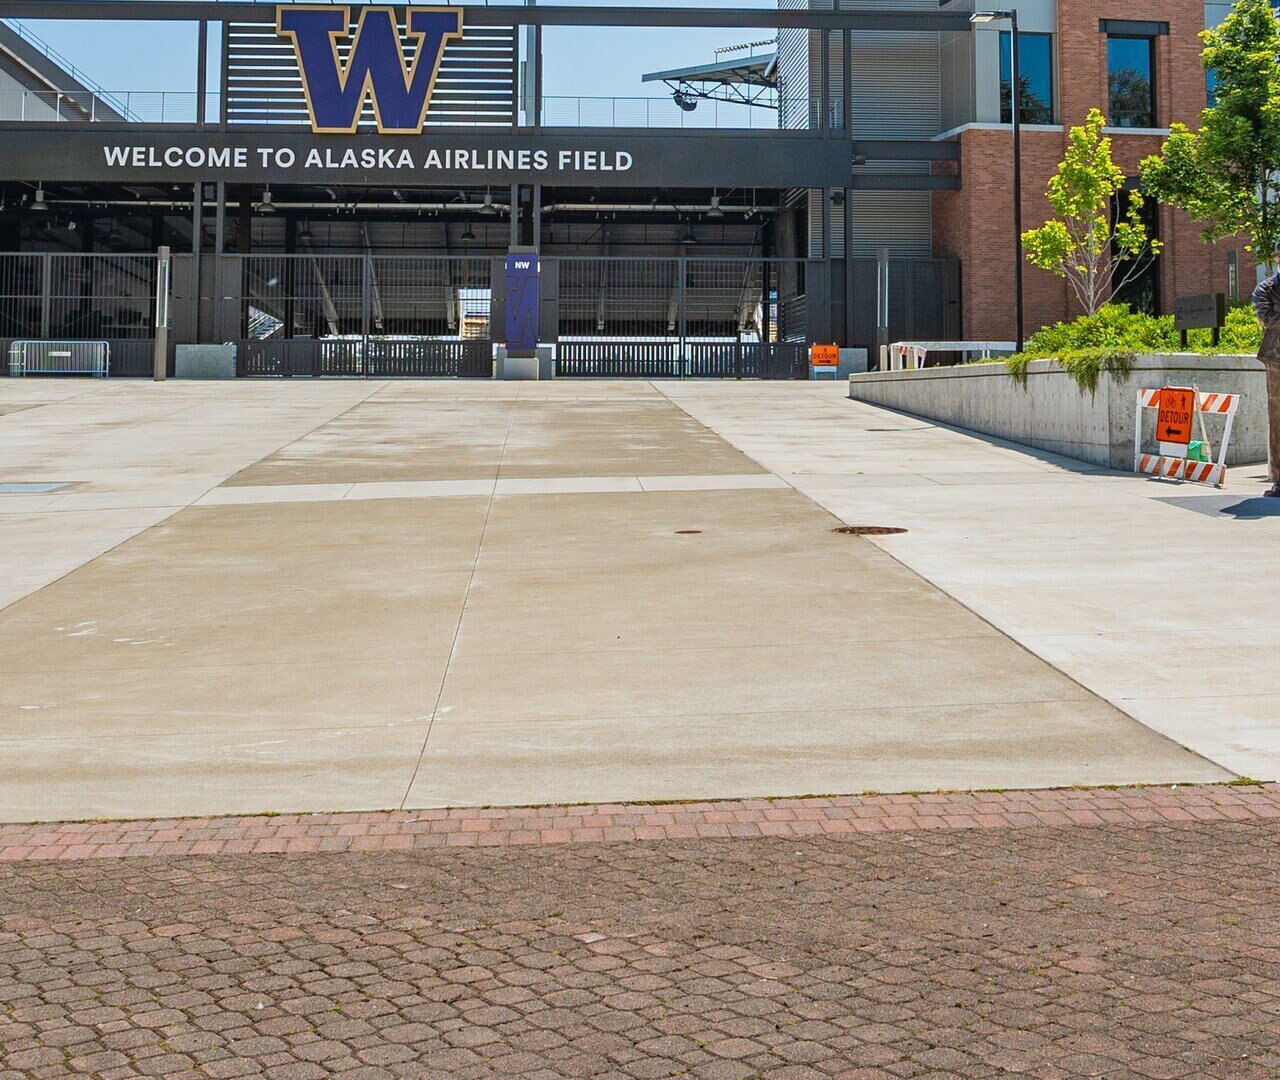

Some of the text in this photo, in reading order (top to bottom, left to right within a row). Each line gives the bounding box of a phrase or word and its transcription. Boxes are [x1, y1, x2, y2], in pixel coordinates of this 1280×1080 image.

[276, 5, 463, 134] W
[103, 146, 633, 171] WELCOME TO ALASKA AIRLINES FIELD
[514, 261, 530, 270] NW
[1160, 410, 1190, 425] DETOUR
